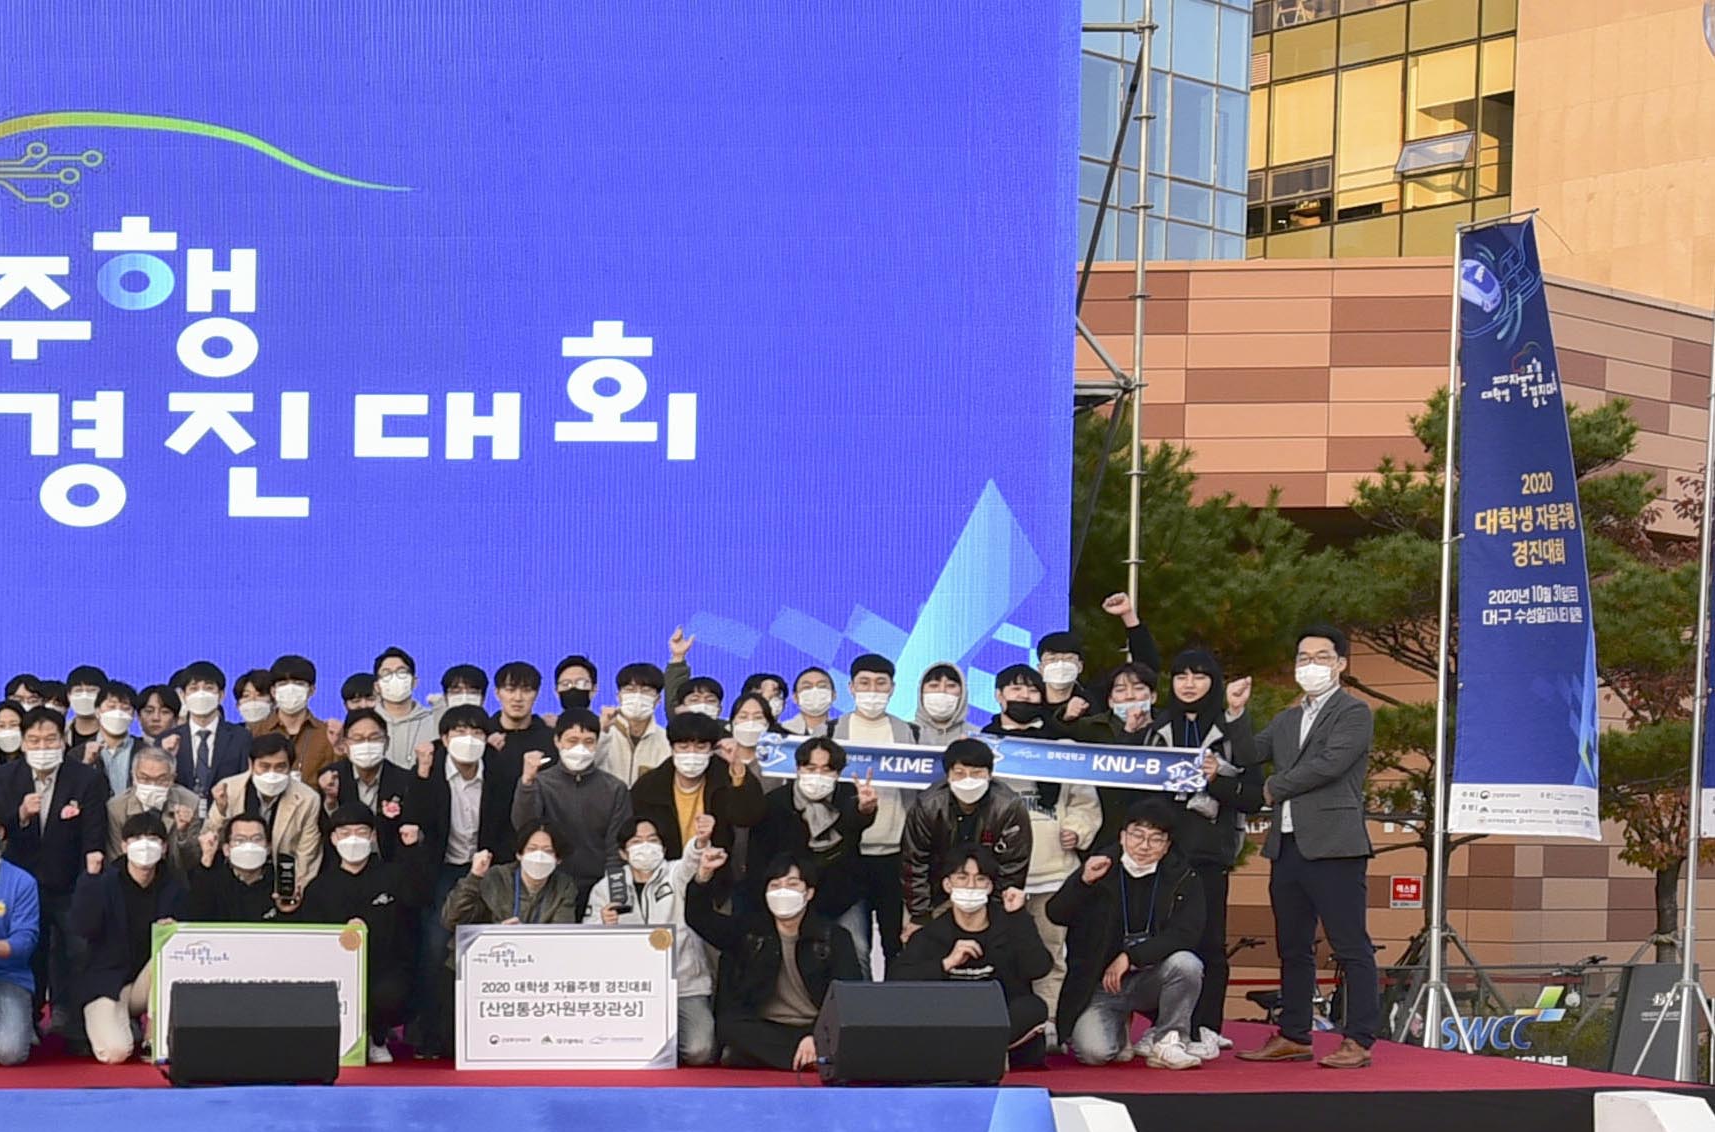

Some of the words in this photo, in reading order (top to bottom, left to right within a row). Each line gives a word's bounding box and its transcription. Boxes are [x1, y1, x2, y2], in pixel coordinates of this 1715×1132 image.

[1521, 471, 1553, 494] 2020
[1475, 505, 1534, 535] 대학생
[1512, 538, 1565, 567] 경진대회
[1489, 588, 1530, 605] 2020년
[1532, 585, 1551, 603] 10월
[1482, 609, 1511, 625] 대구
[880, 755, 934, 774] KIME
[1091, 754, 1161, 775] KNU-B
[481, 982, 510, 994] 2020
[514, 981, 549, 994] 대학생
[553, 981, 600, 993] 자율주행
[605, 981, 652, 993] 경진대회
[479, 1001, 644, 1018] [산업통상자원부장관상]
[1440, 1016, 1537, 1051] SWCC
